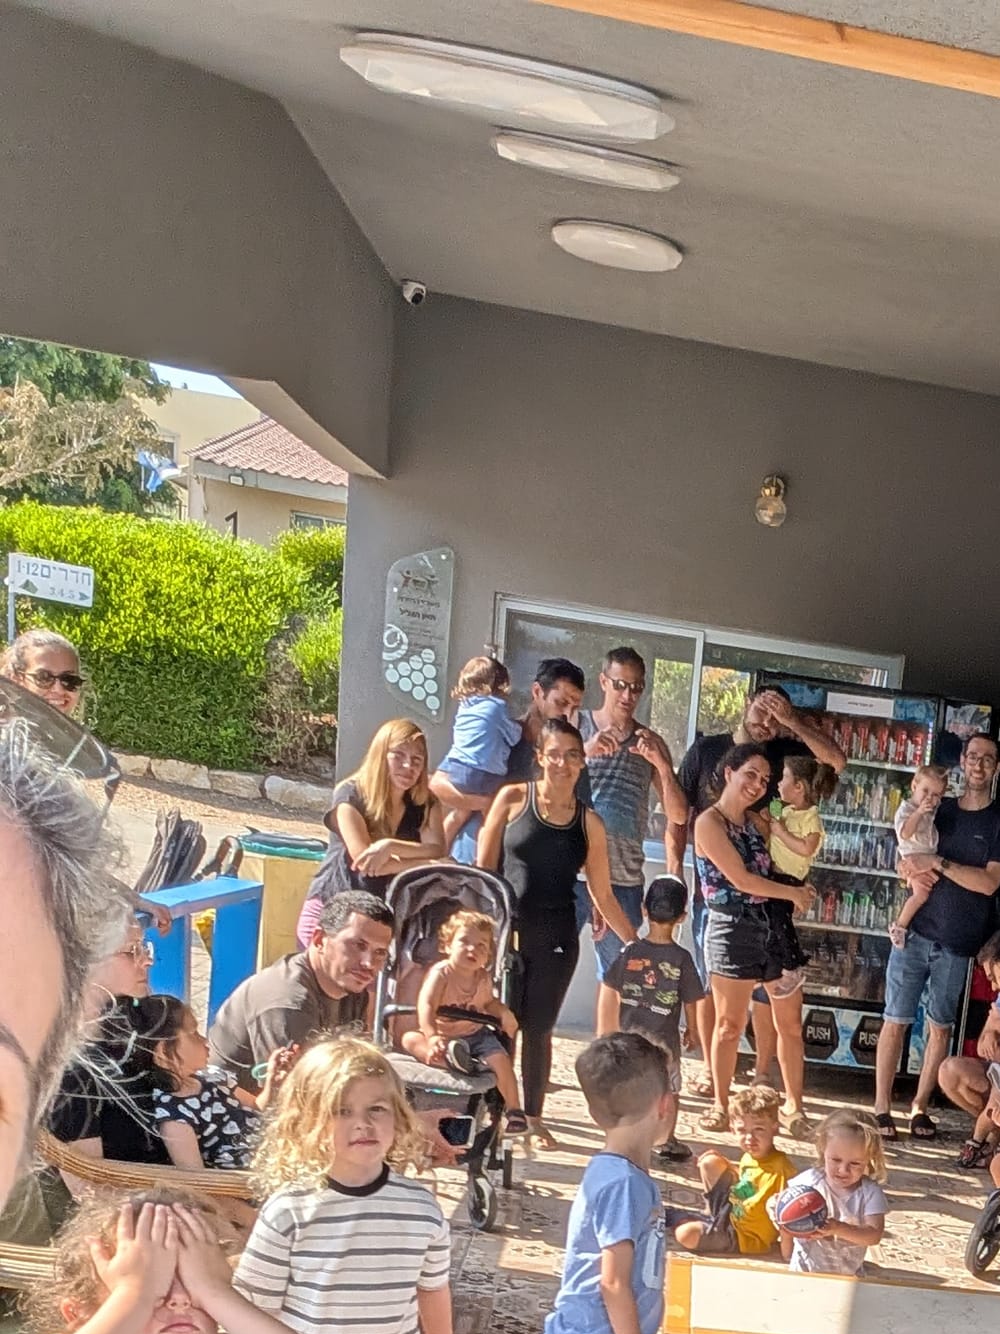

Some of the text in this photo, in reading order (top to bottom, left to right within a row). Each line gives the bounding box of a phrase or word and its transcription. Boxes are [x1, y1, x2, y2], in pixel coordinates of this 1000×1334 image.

[41, 564, 91, 586] חדרים
[806, 1025, 831, 1040] PUSH
[859, 1031, 879, 1046] PUS
